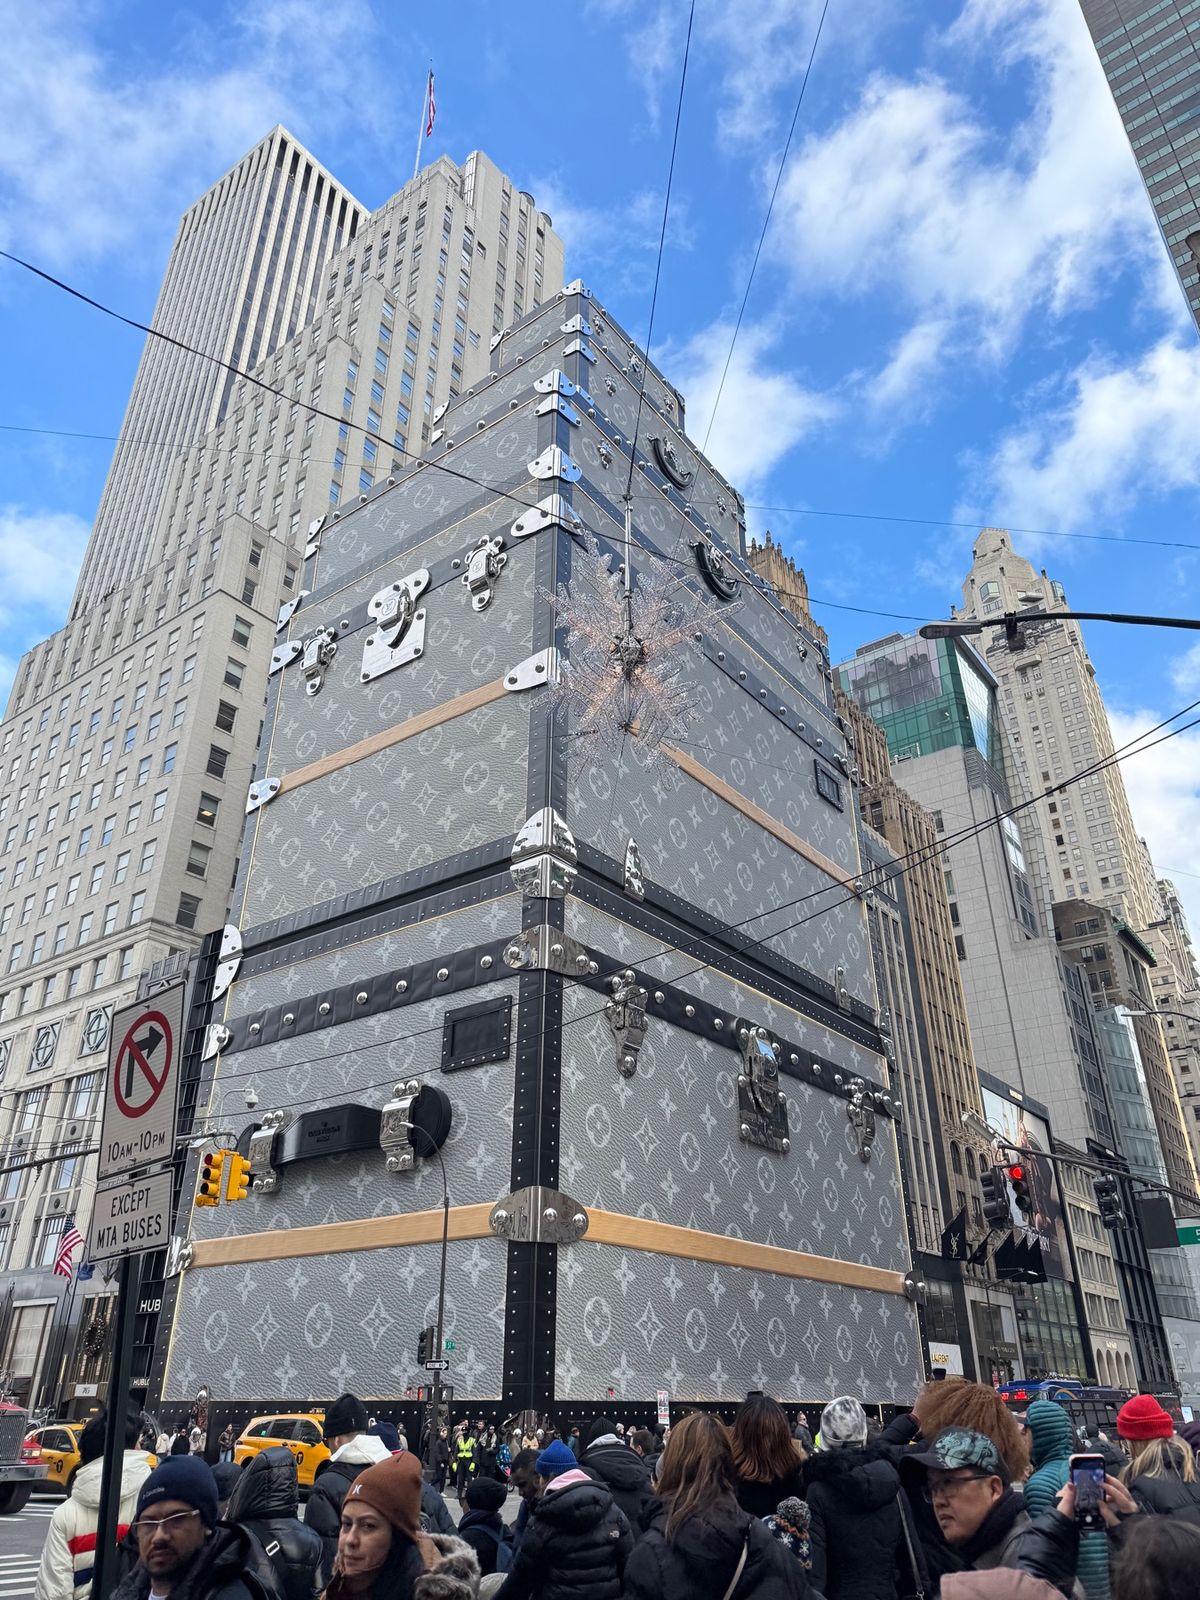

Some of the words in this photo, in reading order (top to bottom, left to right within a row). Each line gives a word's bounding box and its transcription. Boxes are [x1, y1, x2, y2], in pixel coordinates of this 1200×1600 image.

[108, 1131, 165, 1163] 10AM-10PM
[111, 1187, 151, 1217] EXCEPT
[97, 1225, 117, 1250] MTA
[123, 1214, 162, 1243] BUSES
